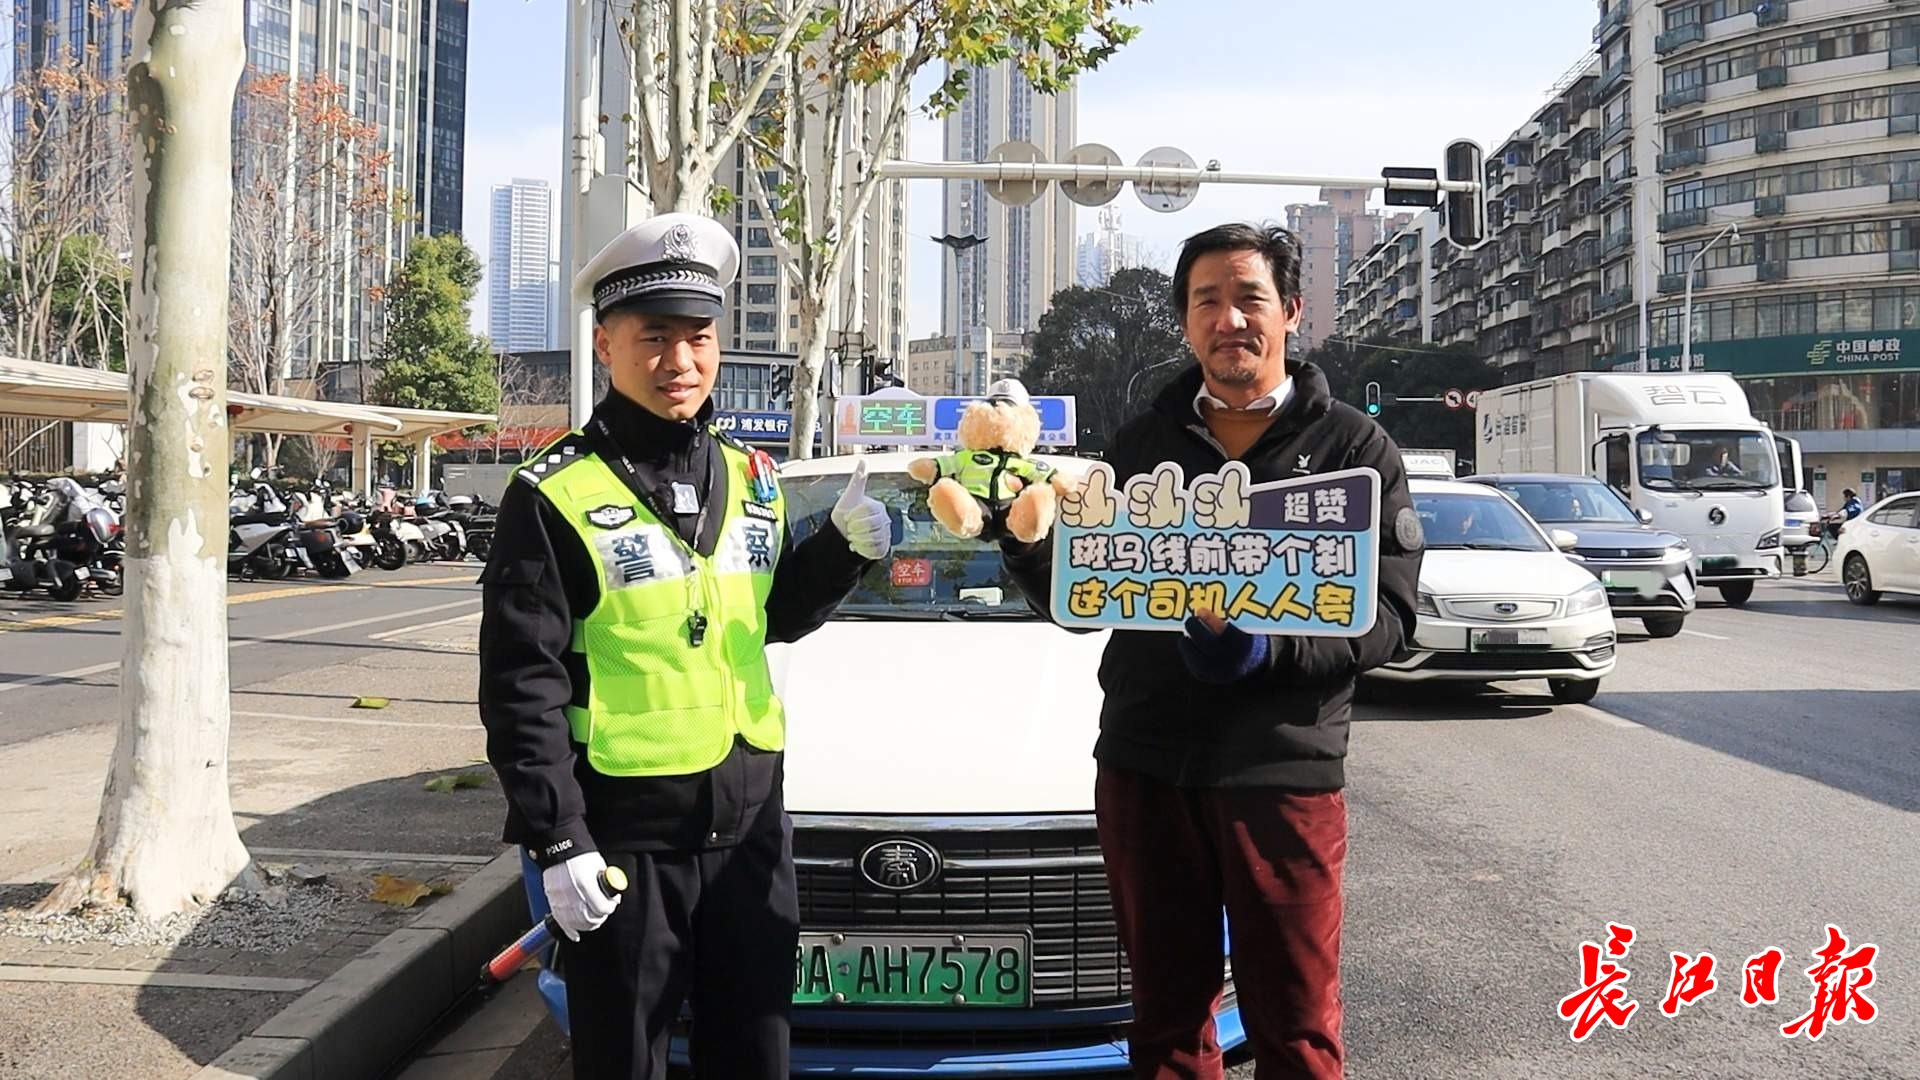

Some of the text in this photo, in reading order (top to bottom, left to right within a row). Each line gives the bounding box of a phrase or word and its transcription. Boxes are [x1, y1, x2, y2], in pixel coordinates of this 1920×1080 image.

[1836, 338, 1900, 354] 中国邮政
[1836, 352, 1900, 363] CHINA POST
[741, 418, 788, 433] 浦发银行
[860, 402, 927, 436] 空车
[1284, 488, 1348, 524] 超赞
[1069, 533, 1356, 576] 斑马线前带个刹
[896, 562, 926, 578] 空车
[1068, 577, 1355, 626] 这个司机人人夸
[545, 839, 574, 856] POLICE
